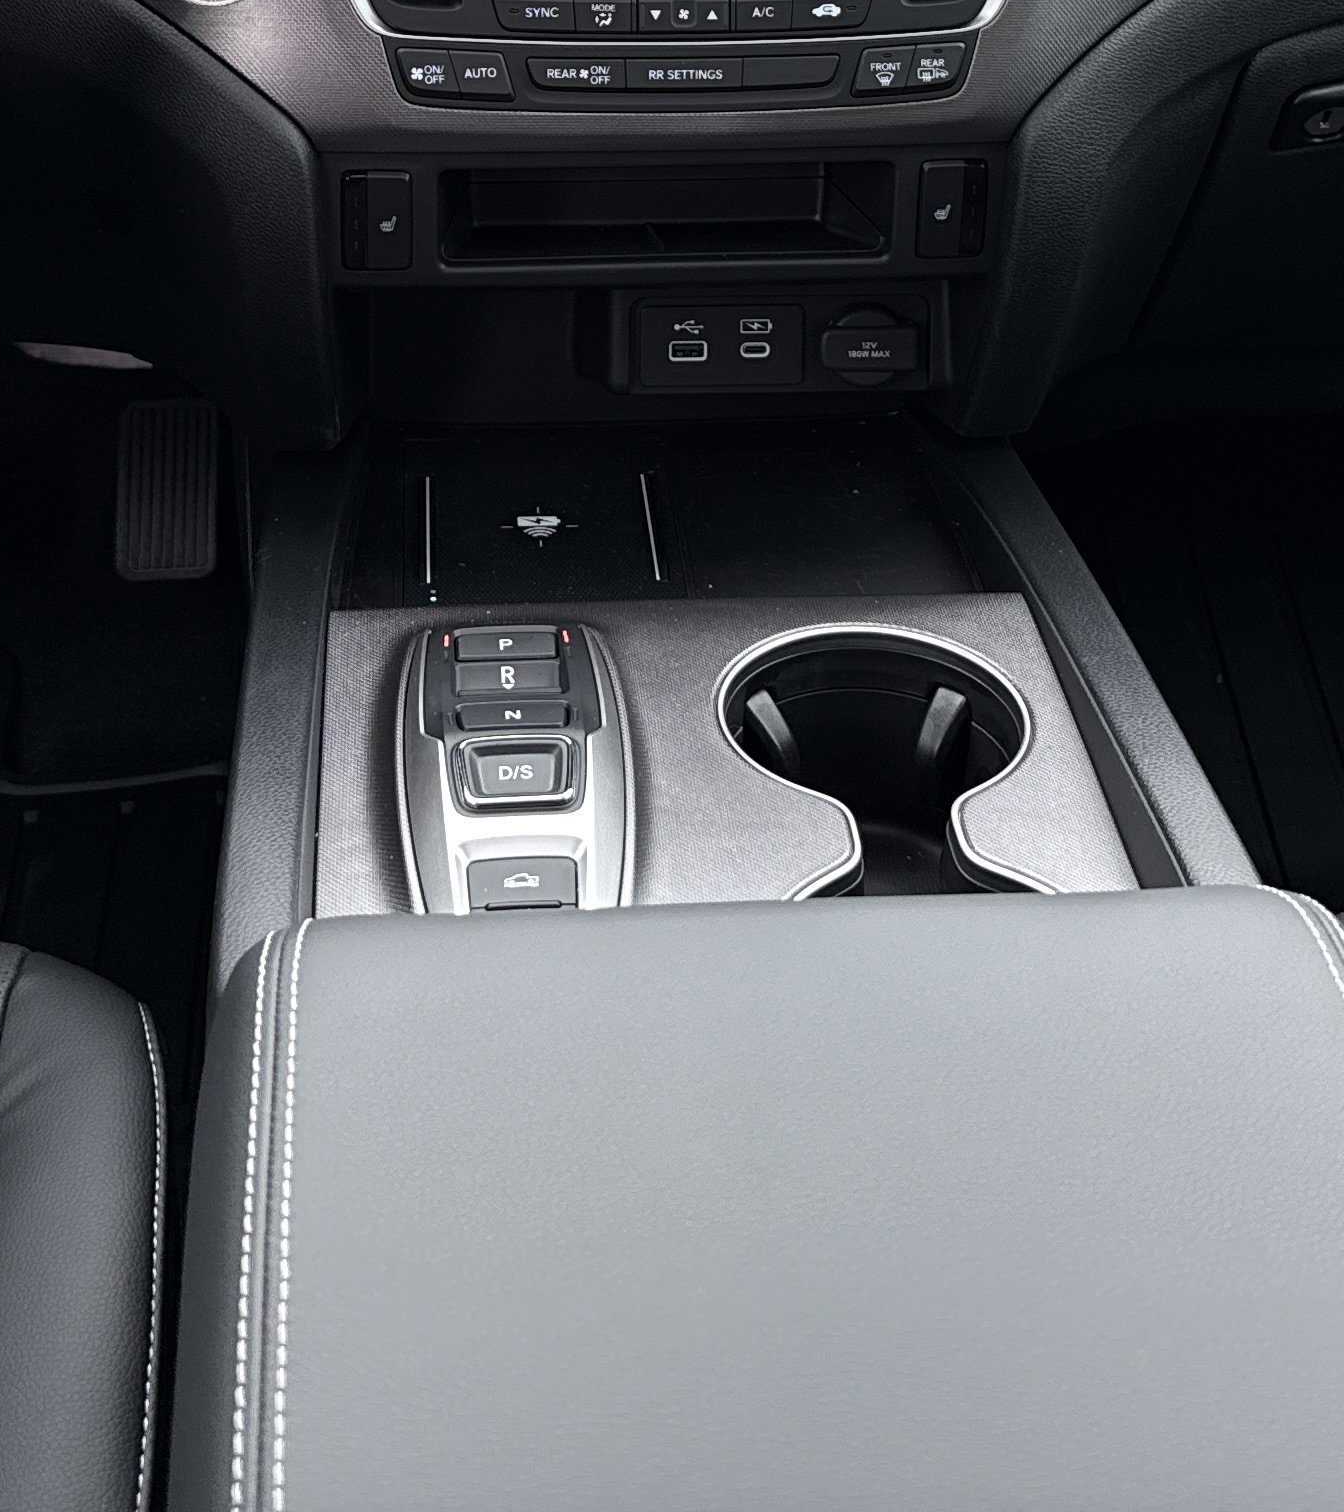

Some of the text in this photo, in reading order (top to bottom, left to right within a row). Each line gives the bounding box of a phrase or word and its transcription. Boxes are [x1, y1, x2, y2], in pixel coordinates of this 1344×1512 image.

[525, 7, 560, 19] SYNC
[591, 3, 616, 12] MODE
[752, 6, 775, 19] A/C
[870, 62, 901, 72] FRONT
[920, 58, 945, 67] REAR
[424, 64, 445, 75] ON/
[464, 66, 497, 80] AUTO
[547, 68, 577, 80] REAR
[590, 65, 611, 76] ON/
[648, 69, 723, 81] RR SETTINGS
[424, 74, 445, 85] OFF
[590, 74, 611, 85] OFF
[861, 341, 878, 349] 12V
[498, 638, 513, 651] P
[500, 665, 515, 684] R
[504, 710, 521, 720] N
[498, 764, 534, 781] D/S
